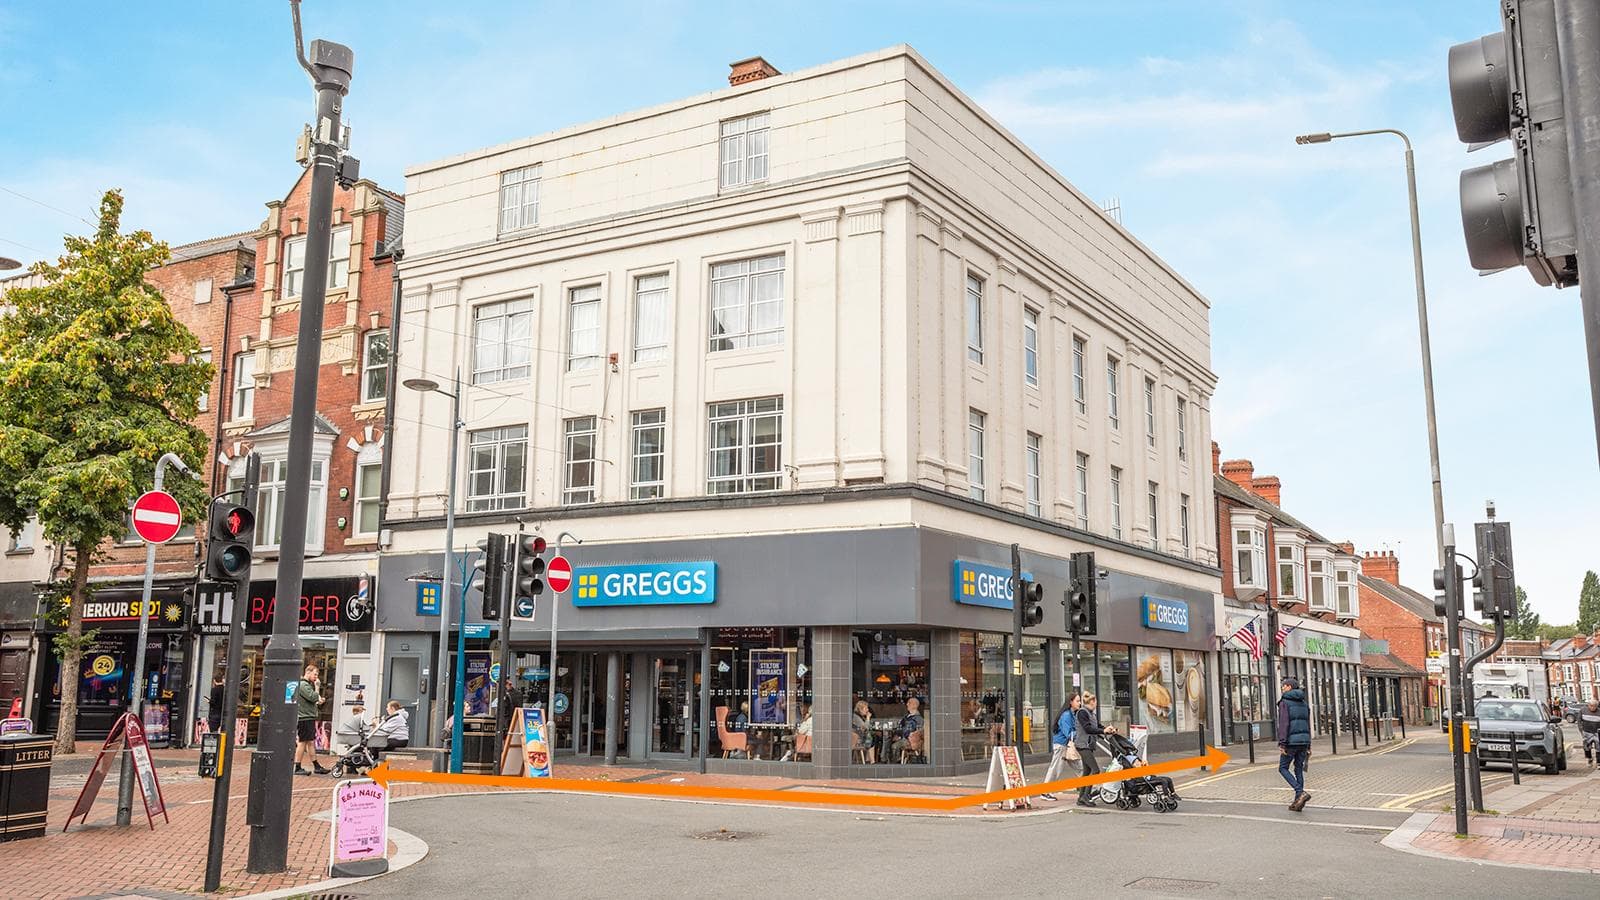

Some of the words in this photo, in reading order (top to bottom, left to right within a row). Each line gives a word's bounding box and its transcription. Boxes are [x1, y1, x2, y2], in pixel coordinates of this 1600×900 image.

[603, 570, 707, 598] GREGGS
[977, 572, 1014, 601] GREG
[251, 595, 340, 624] BABER
[1157, 604, 1187, 626] GREGGS
[16, 750, 50, 761] LITTER
[341, 791, 357, 803] E&J
[359, 789, 383, 800] NAILS
